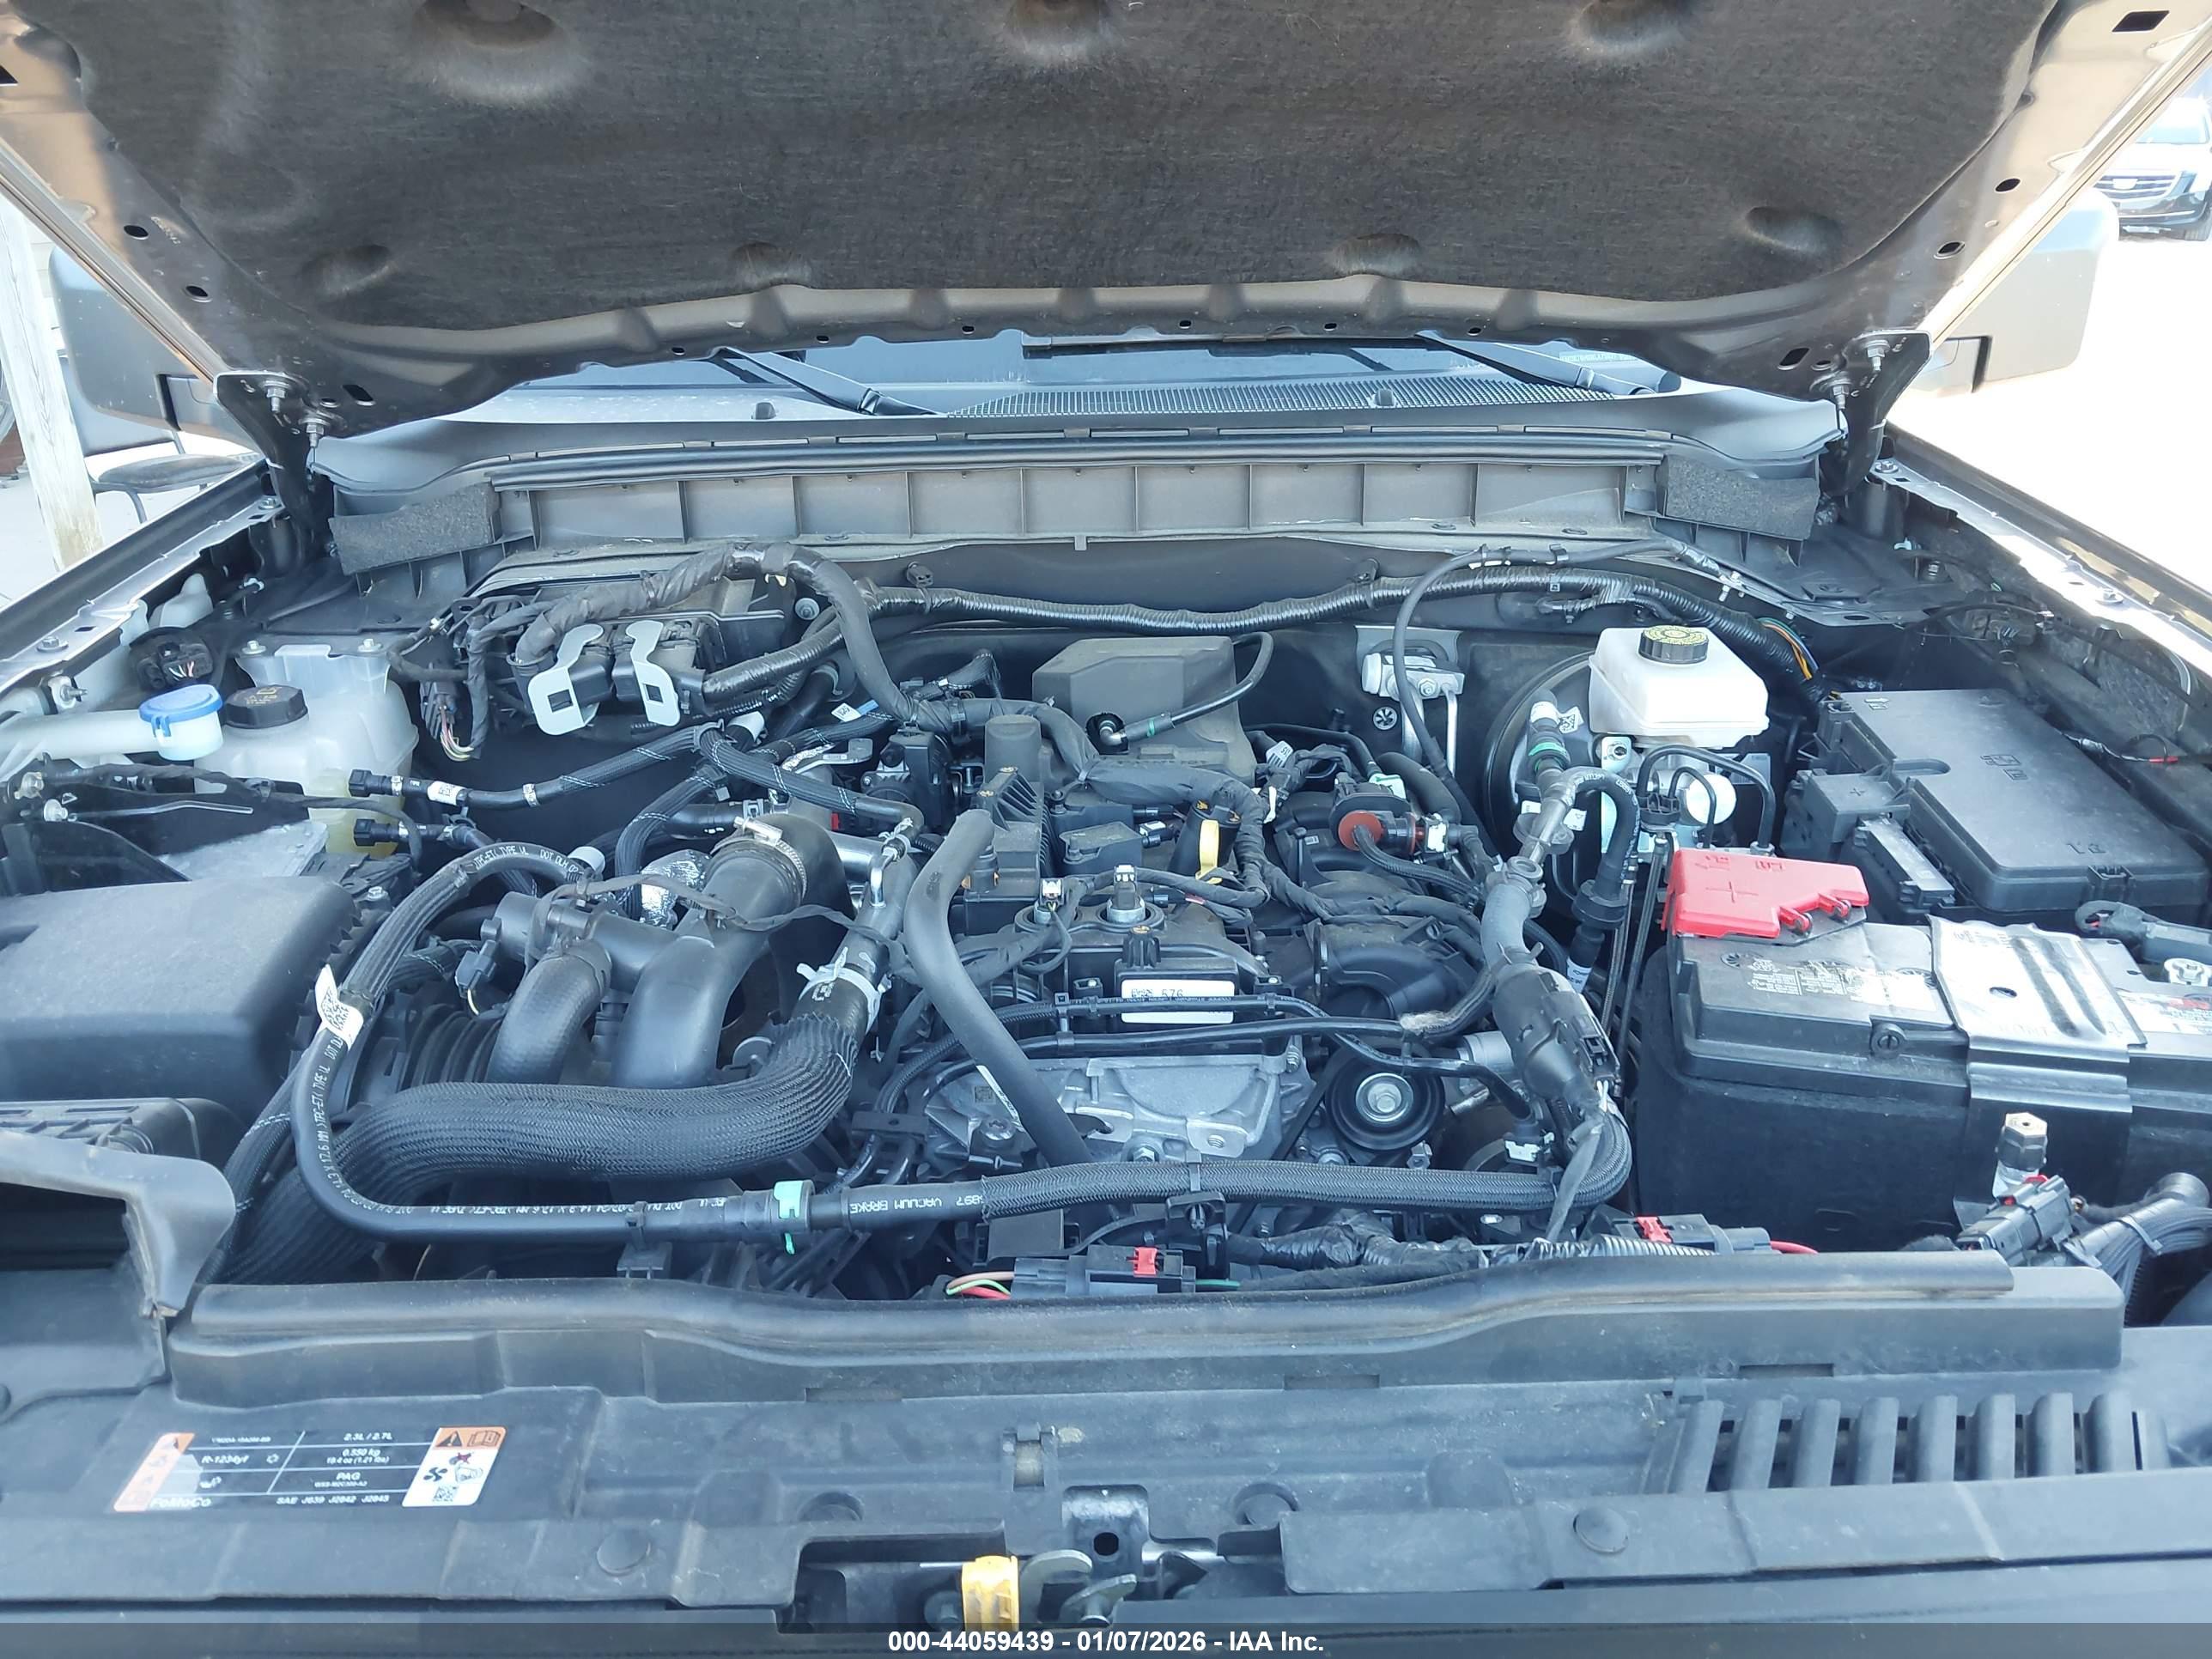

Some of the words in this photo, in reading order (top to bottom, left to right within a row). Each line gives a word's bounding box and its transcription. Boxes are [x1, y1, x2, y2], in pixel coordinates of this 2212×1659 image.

[499, 844, 517, 857] TYPE
[540, 849, 554, 860] DOT
[312, 1072, 327, 1091] TYPE
[850, 1200, 888, 1214] BRAKE
[894, 1197, 942, 1210] VACUUM
[336, 1471, 361, 1481] PAG
[149, 1497, 212, 1508] FoMoCo
[276, 1496, 299, 1505] SAE
